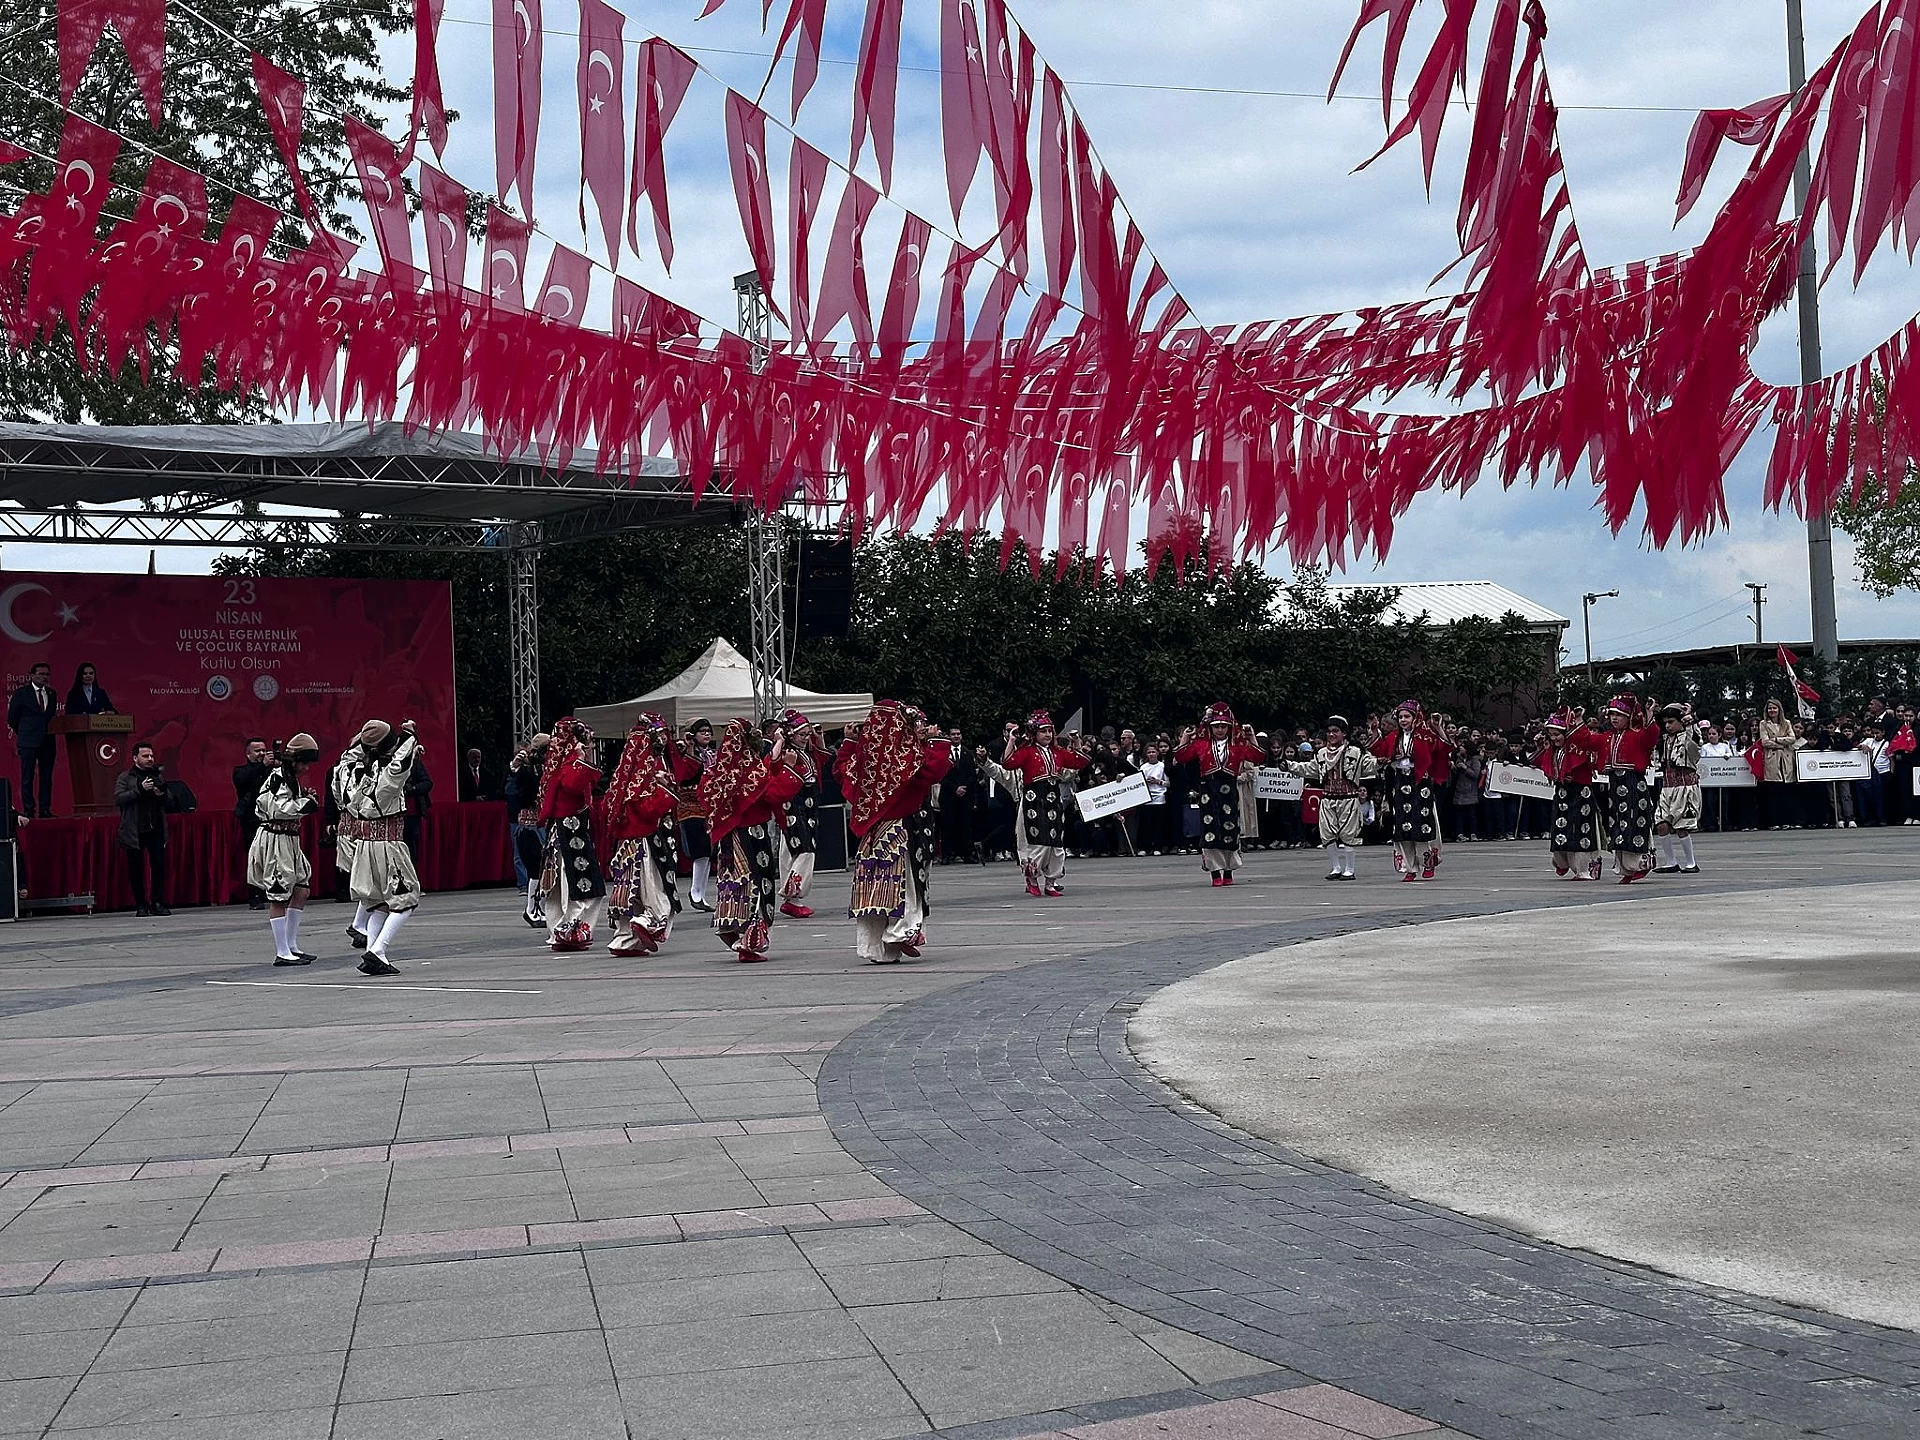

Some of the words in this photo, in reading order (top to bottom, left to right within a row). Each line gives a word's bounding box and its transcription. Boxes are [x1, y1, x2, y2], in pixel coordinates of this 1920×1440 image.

[223, 580, 256, 604] 23
[216, 608, 262, 624] NİSAN
[179, 629, 225, 640] ULUSAL
[229, 626, 298, 640] EGEMENLİK
[176, 641, 192, 652] VE
[195, 641, 242, 654] ÇOCUK
[246, 642, 301, 652] BAYRAMI
[200, 656, 236, 670] Kutlu
[241, 656, 281, 670] Olsun
[1259, 787, 1299, 795] ORTAOKULU
